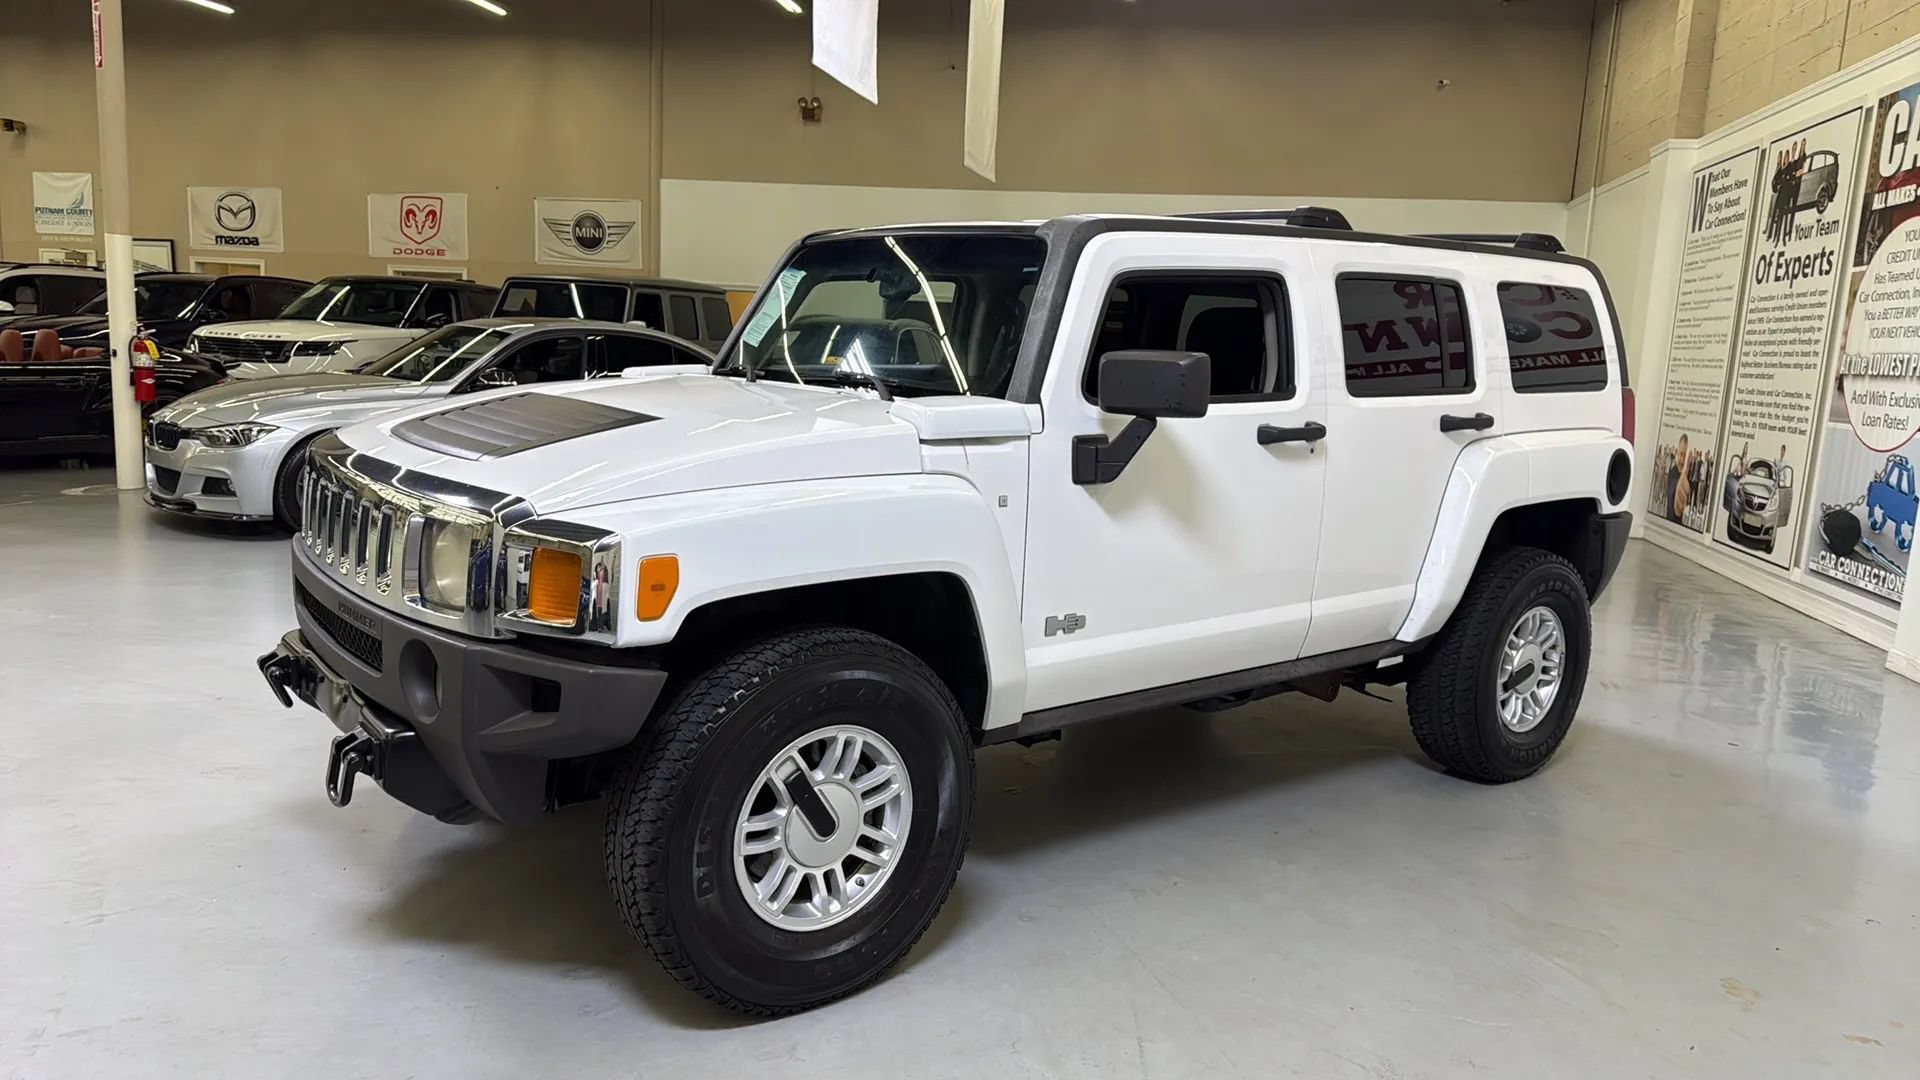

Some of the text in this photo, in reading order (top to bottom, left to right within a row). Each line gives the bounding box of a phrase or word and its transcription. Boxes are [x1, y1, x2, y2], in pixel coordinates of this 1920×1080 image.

[1879, 95, 1920, 177] CA
[1709, 178, 1748, 199] Members Have
[35, 207, 93, 216] PUTNAM COUNTY
[1714, 201, 1723, 214] Say
[1724, 196, 1741, 209] About
[1705, 208, 1747, 230] Car Connection!
[575, 226, 603, 239] MINI
[1794, 219, 1840, 242] Your Team
[1905, 229, 1920, 242] YOU
[215, 235, 259, 246] mazda
[393, 247, 447, 256] DODGE
[1886, 248, 1913, 264] CREDIT
[1755, 251, 1775, 285] Of
[1774, 246, 1835, 289] Experts
[1874, 273, 1887, 285] Has
[1887, 268, 1914, 283] Teamed
[1859, 291, 1870, 303] Car
[1864, 309, 1877, 321] You
[1850, 353, 1868, 376] the
[1868, 352, 1910, 377] LOWEST
[1850, 390, 1920, 409] And With Exclusi
[1862, 411, 1910, 431] Loan Rates!
[1819, 550, 1837, 569] CAR
